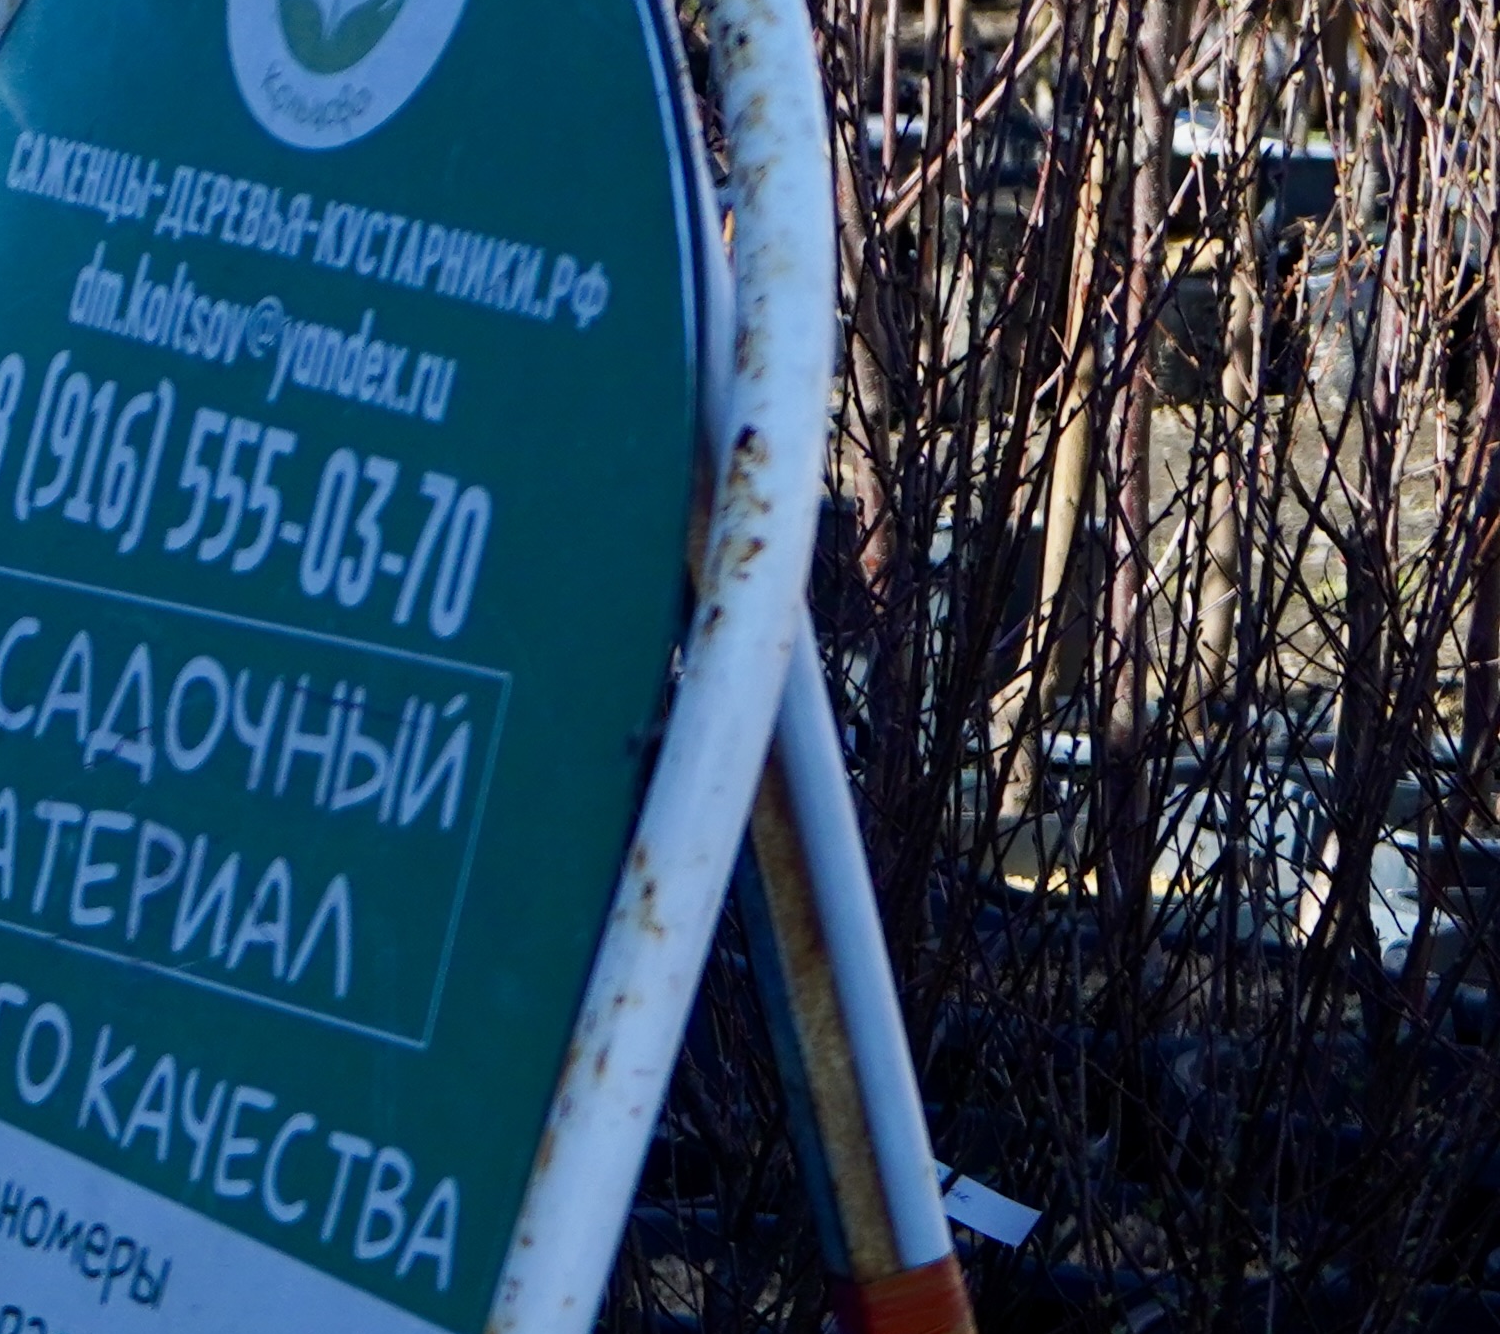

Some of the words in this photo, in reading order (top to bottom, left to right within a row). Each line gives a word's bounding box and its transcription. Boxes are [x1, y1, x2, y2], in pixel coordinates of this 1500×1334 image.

[7, 131, 611, 329] САЖЕНЦЫ-ДЕРЕВЬЯ-КУСТАРНИКИ.РФ
[69, 243, 457, 422] dm.koltsov@yandex.ru
[15, 350, 175, 553] (916)
[165, 408, 492, 639] 555-03-70
[80, 1024, 462, 1291] КАЧЕСТВА
